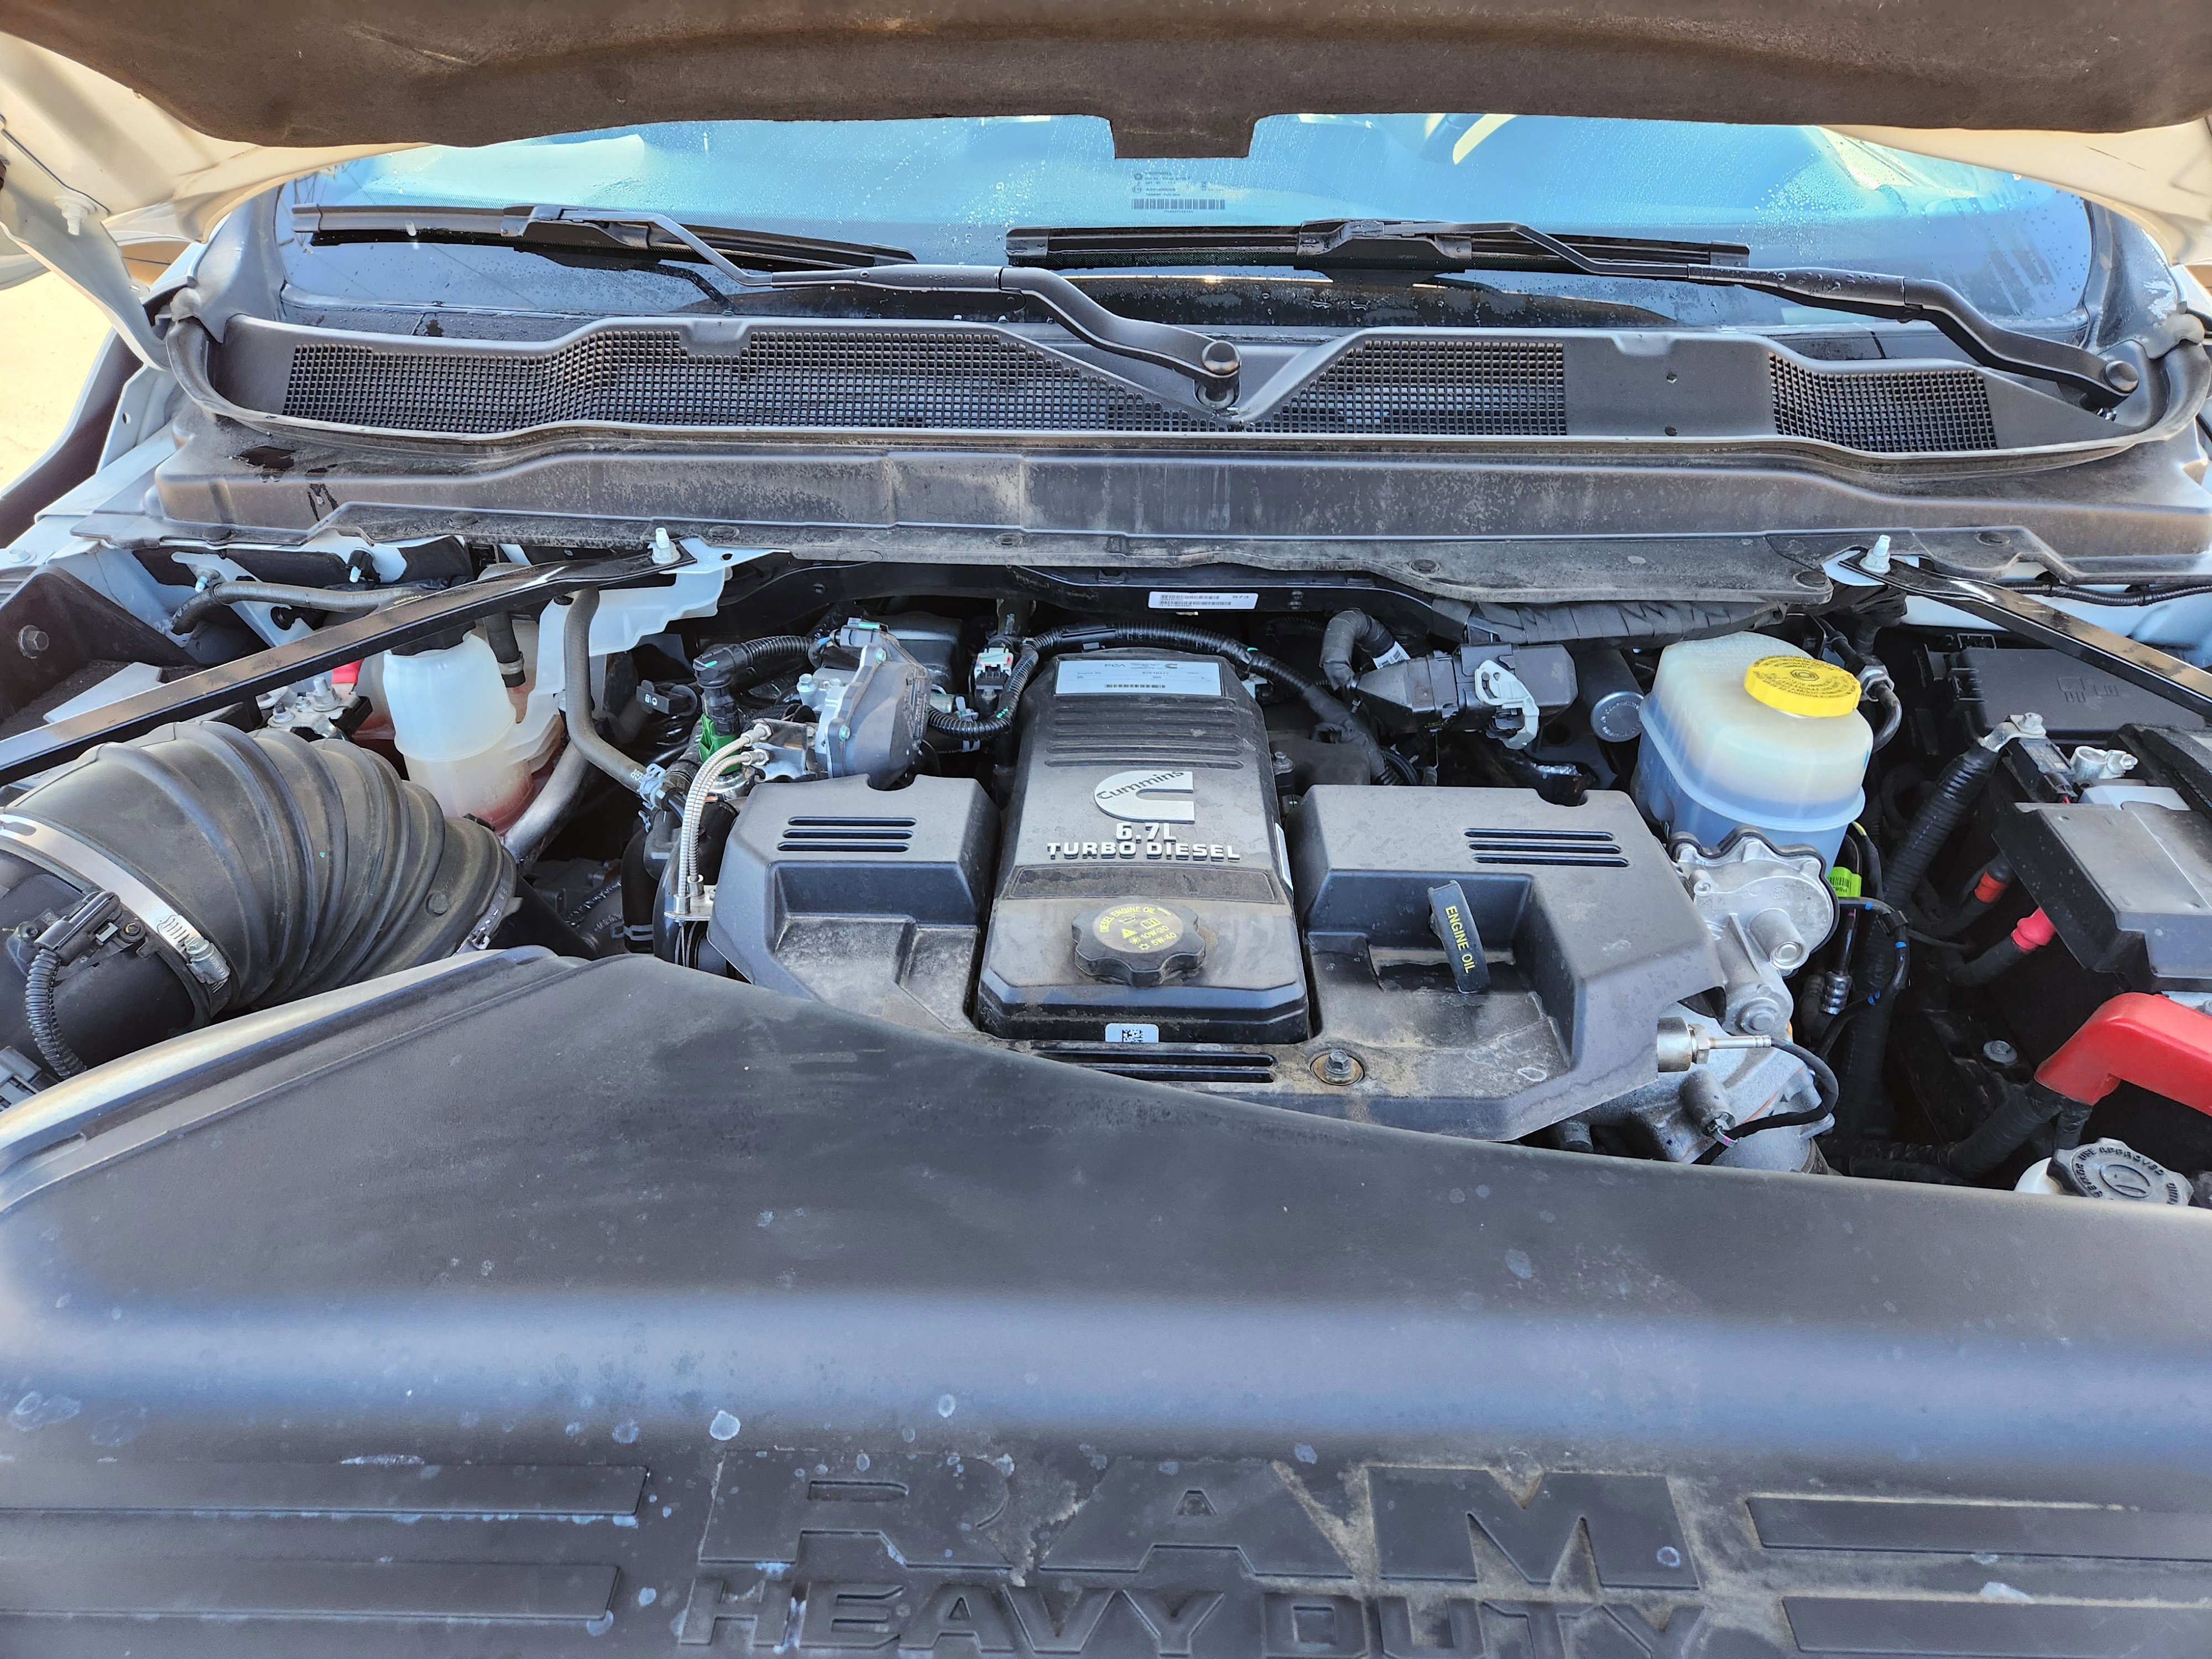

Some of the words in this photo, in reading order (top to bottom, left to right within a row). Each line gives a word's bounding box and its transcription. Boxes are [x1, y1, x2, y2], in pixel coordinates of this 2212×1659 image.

[1096, 770, 1185, 800] Cummins
[1116, 822, 1177, 844] 6.7L
[1047, 841, 1136, 859] TURBO
[1146, 841, 1241, 863] DIESEL
[1100, 916, 1115, 932] DIESEL
[1110, 906, 1141, 917] ENGINE
[1143, 906, 1155, 915] OIL
[1141, 925, 1170, 939] 10W-30
[1151, 932, 1177, 946] 5W-40
[1445, 905, 1469, 951] ENGINE
[1461, 953, 1475, 974] OIL
[2078, 1148, 2097, 1161] USE
[2099, 1146, 2165, 1176] APPROVED
[2075, 1162, 2103, 1198] POWER
[700, 1448, 1700, 1590] RAM
[679, 1577, 1225, 1657] HEAVY
[1262, 1592, 1708, 1659] DUTY
